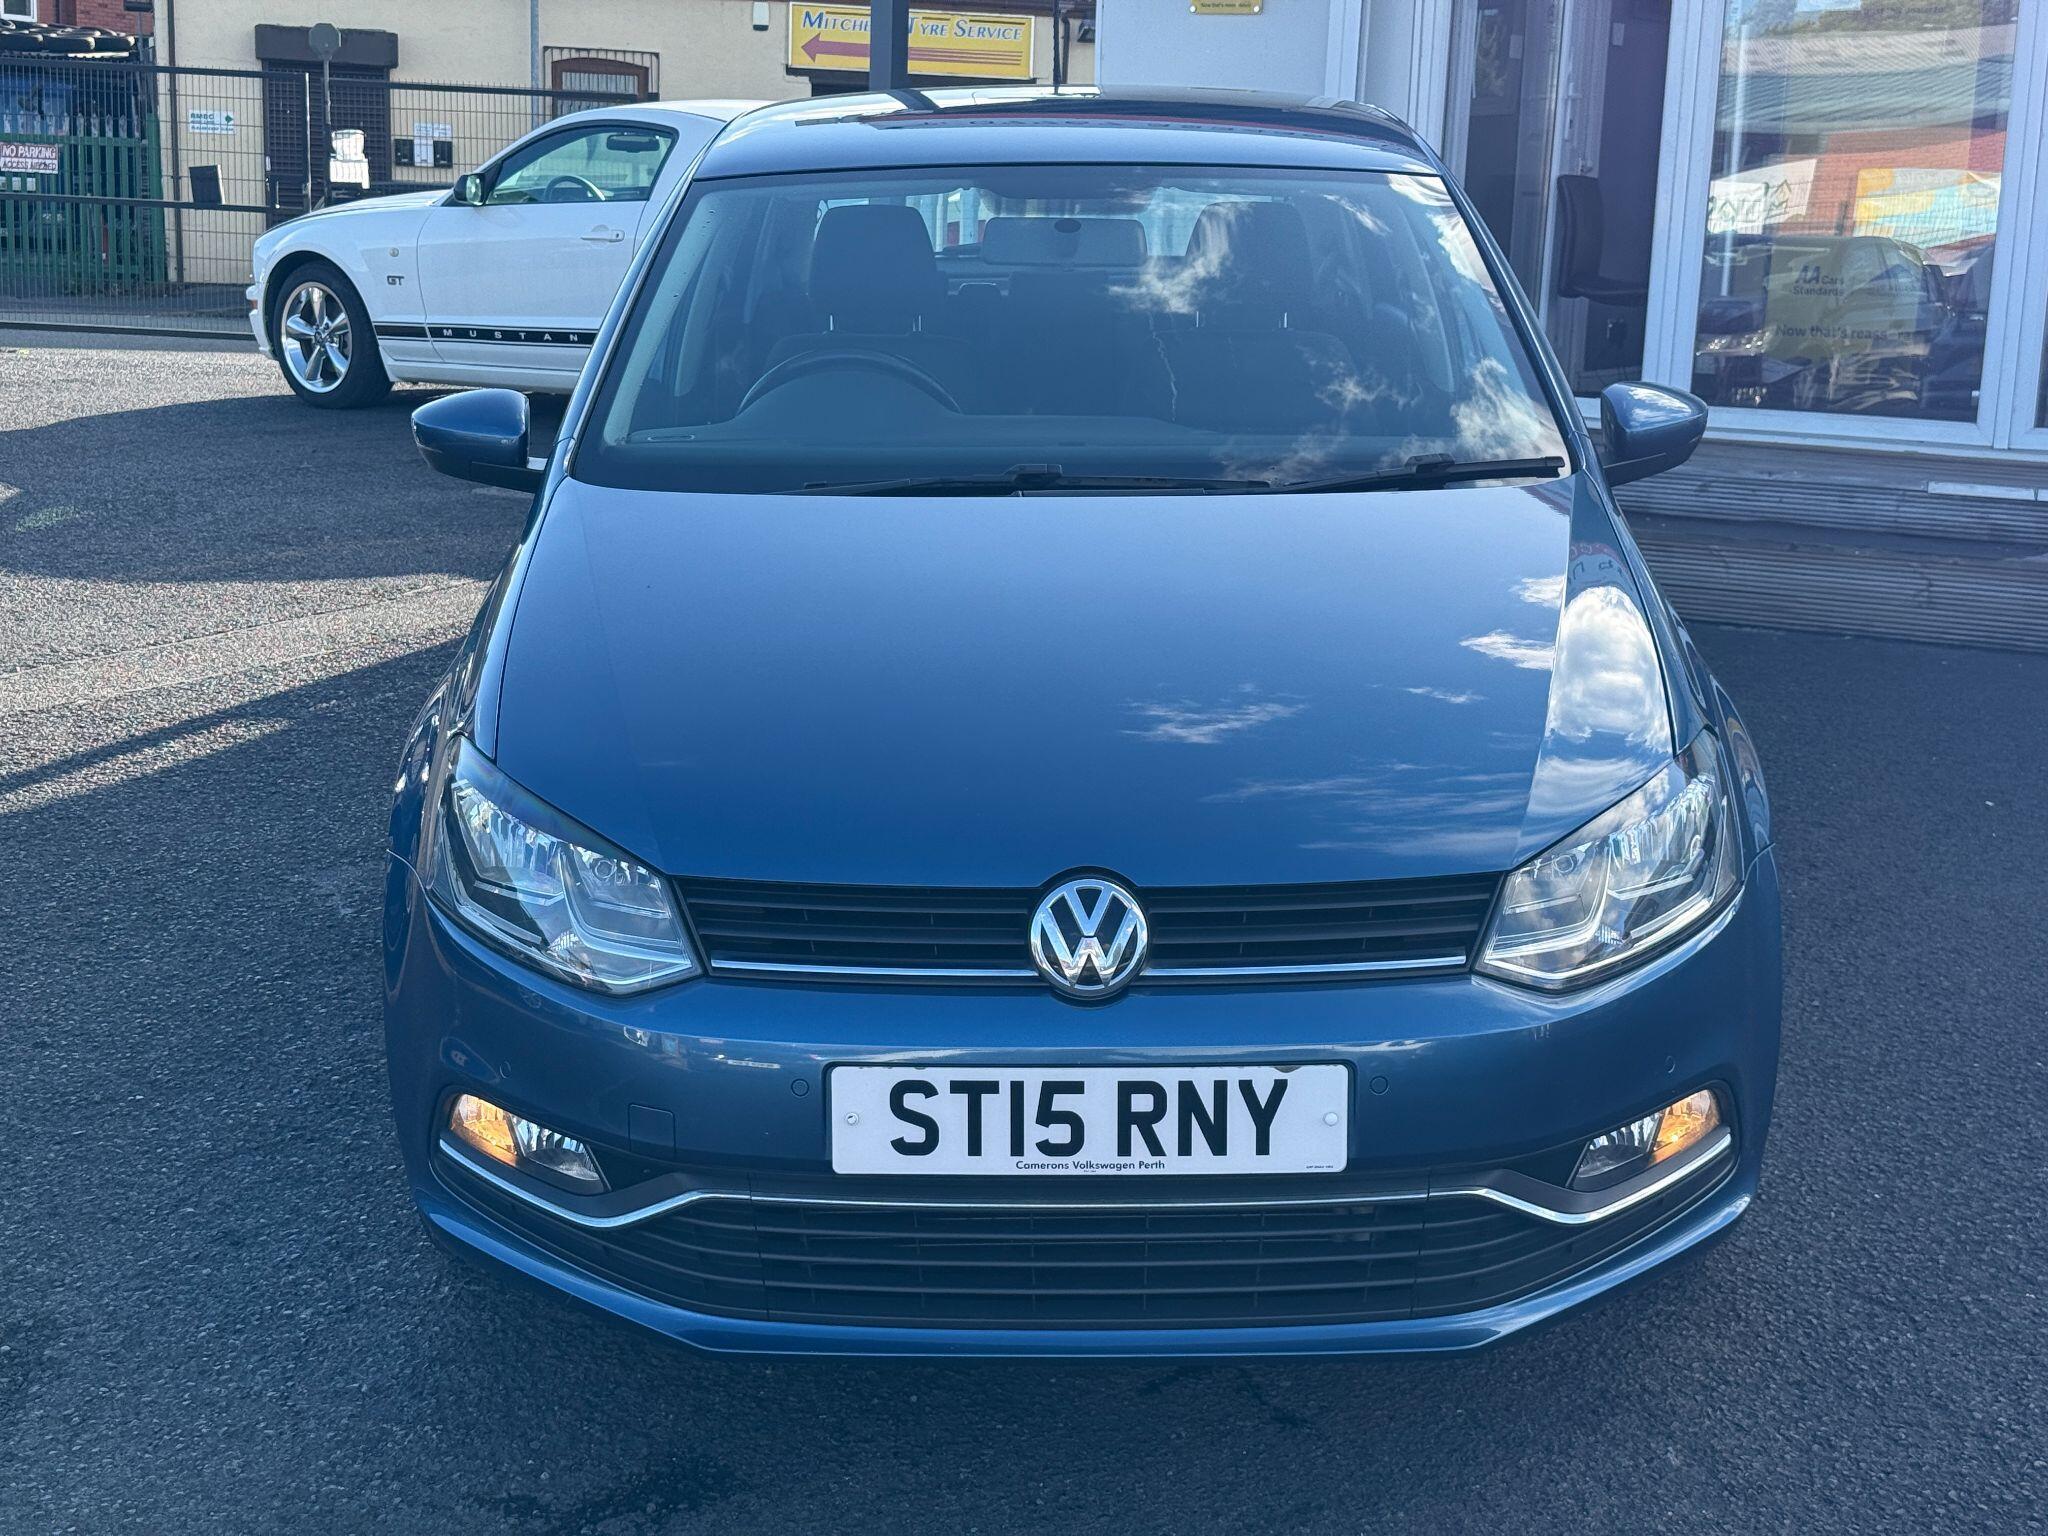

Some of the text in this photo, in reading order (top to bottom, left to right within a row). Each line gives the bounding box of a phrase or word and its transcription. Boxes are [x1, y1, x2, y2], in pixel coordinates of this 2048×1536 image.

[954, 19, 1023, 40] SERVICE
[2, 144, 56, 159] NO PARKING
[387, 275, 405, 286] GT
[1791, 286, 1845, 297] Standards
[442, 327, 579, 342] MUSTAN
[1775, 323, 1806, 337] Now
[1809, 324, 1847, 338] that's
[888, 1078, 1289, 1158] ST15 RNY
[1015, 1160, 1165, 1172] Camerons Volkswagen Perth
